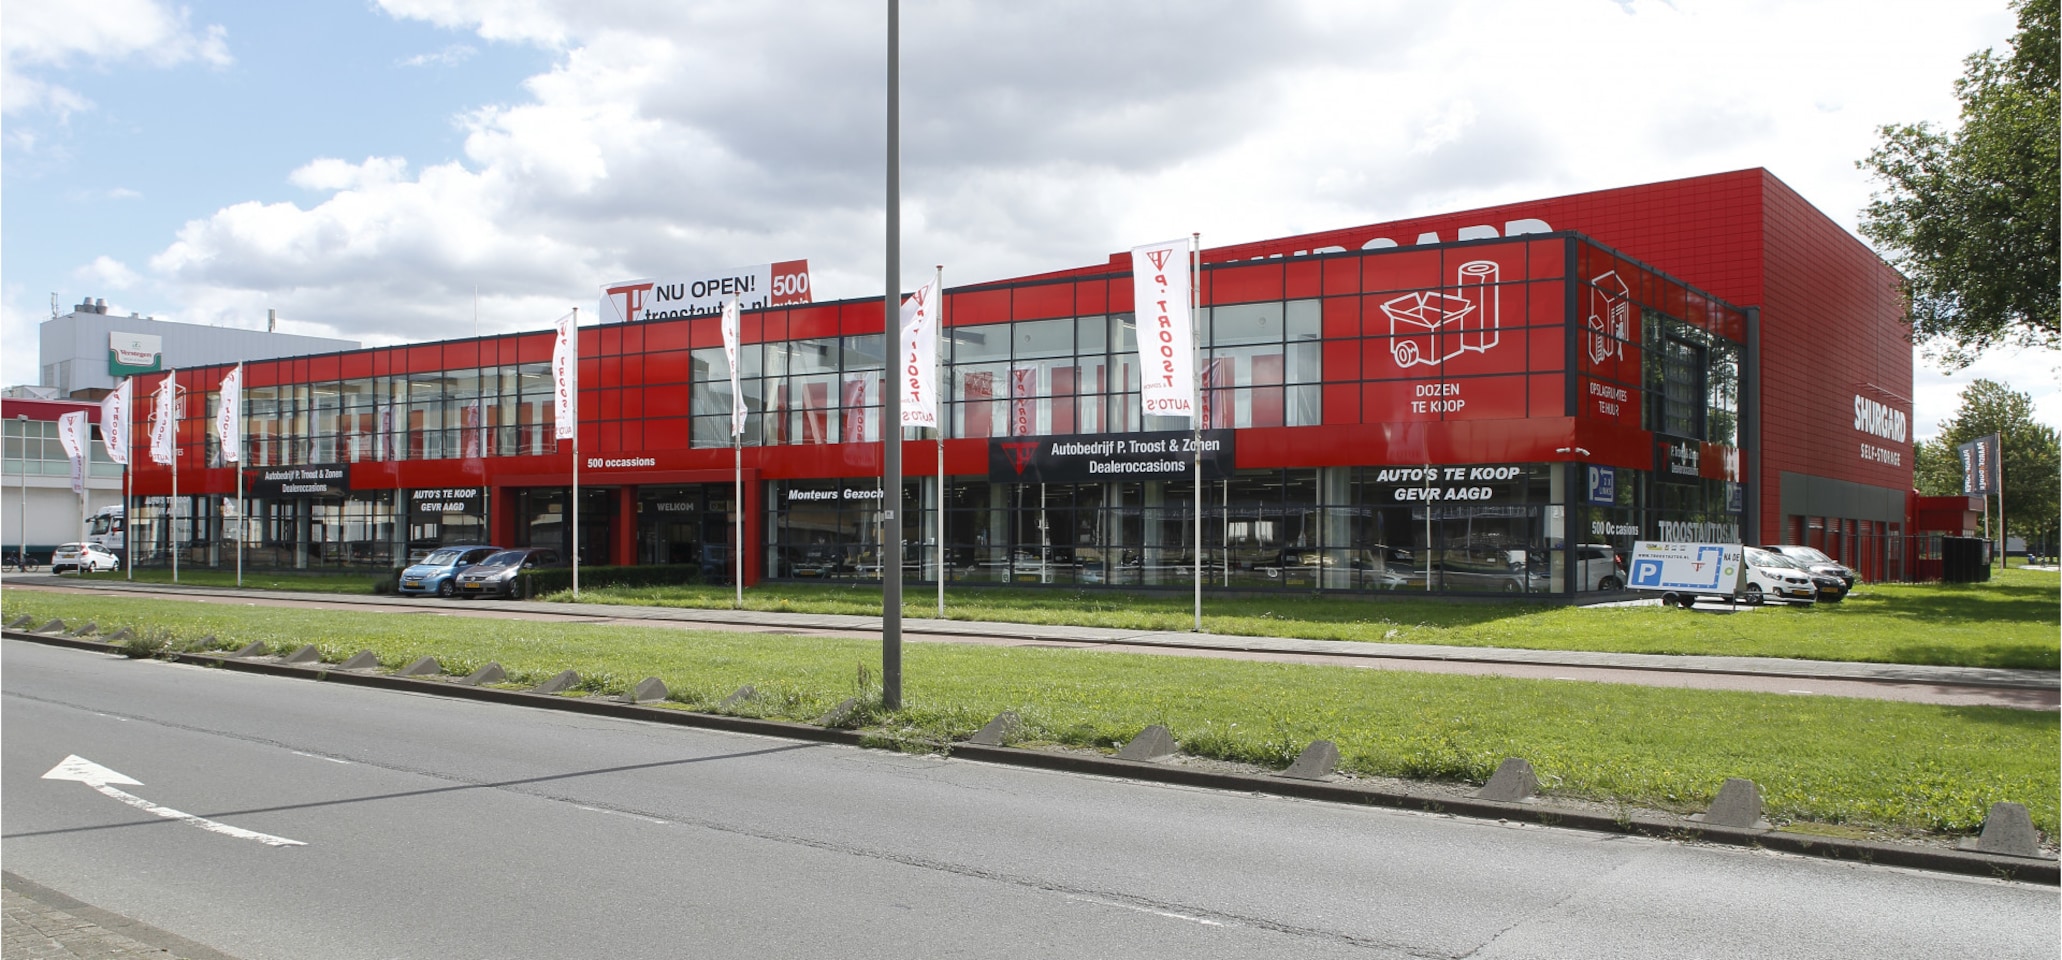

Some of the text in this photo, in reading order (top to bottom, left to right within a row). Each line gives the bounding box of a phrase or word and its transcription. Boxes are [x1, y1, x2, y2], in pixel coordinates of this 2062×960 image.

[656, 274, 756, 302] NU OPEN!
[772, 272, 809, 297] 500
[1415, 383, 1460, 397] DOZEN
[1411, 399, 1465, 413] TE KOOP
[1854, 394, 1906, 443] SHURGARD
[1051, 441, 1115, 457] Autobedrijf
[1117, 441, 1127, 454] P.
[1129, 440, 1166, 453] Troost
[1169, 439, 1179, 452] &
[1860, 443, 1901, 467] SELF-STORAGE
[587, 457, 656, 468] 500 occassions
[1089, 459, 1186, 474] Dealeroccasions
[264, 471, 295, 481] Autobedrijf
[301, 469, 319, 479] Troost
[324, 468, 344, 479] Zonen
[1376, 466, 1521, 481] AUTO'S TE KOOP
[282, 482, 328, 493] Dealeroccasions
[1588, 466, 1599, 500] P
[413, 488, 477, 499] AUTO'S TE KOOP
[788, 488, 884, 500] Monteurs Gezoch
[656, 502, 694, 511] WELKOM
[1592, 521, 1604, 535] 500
[1638, 563, 1657, 583] P
